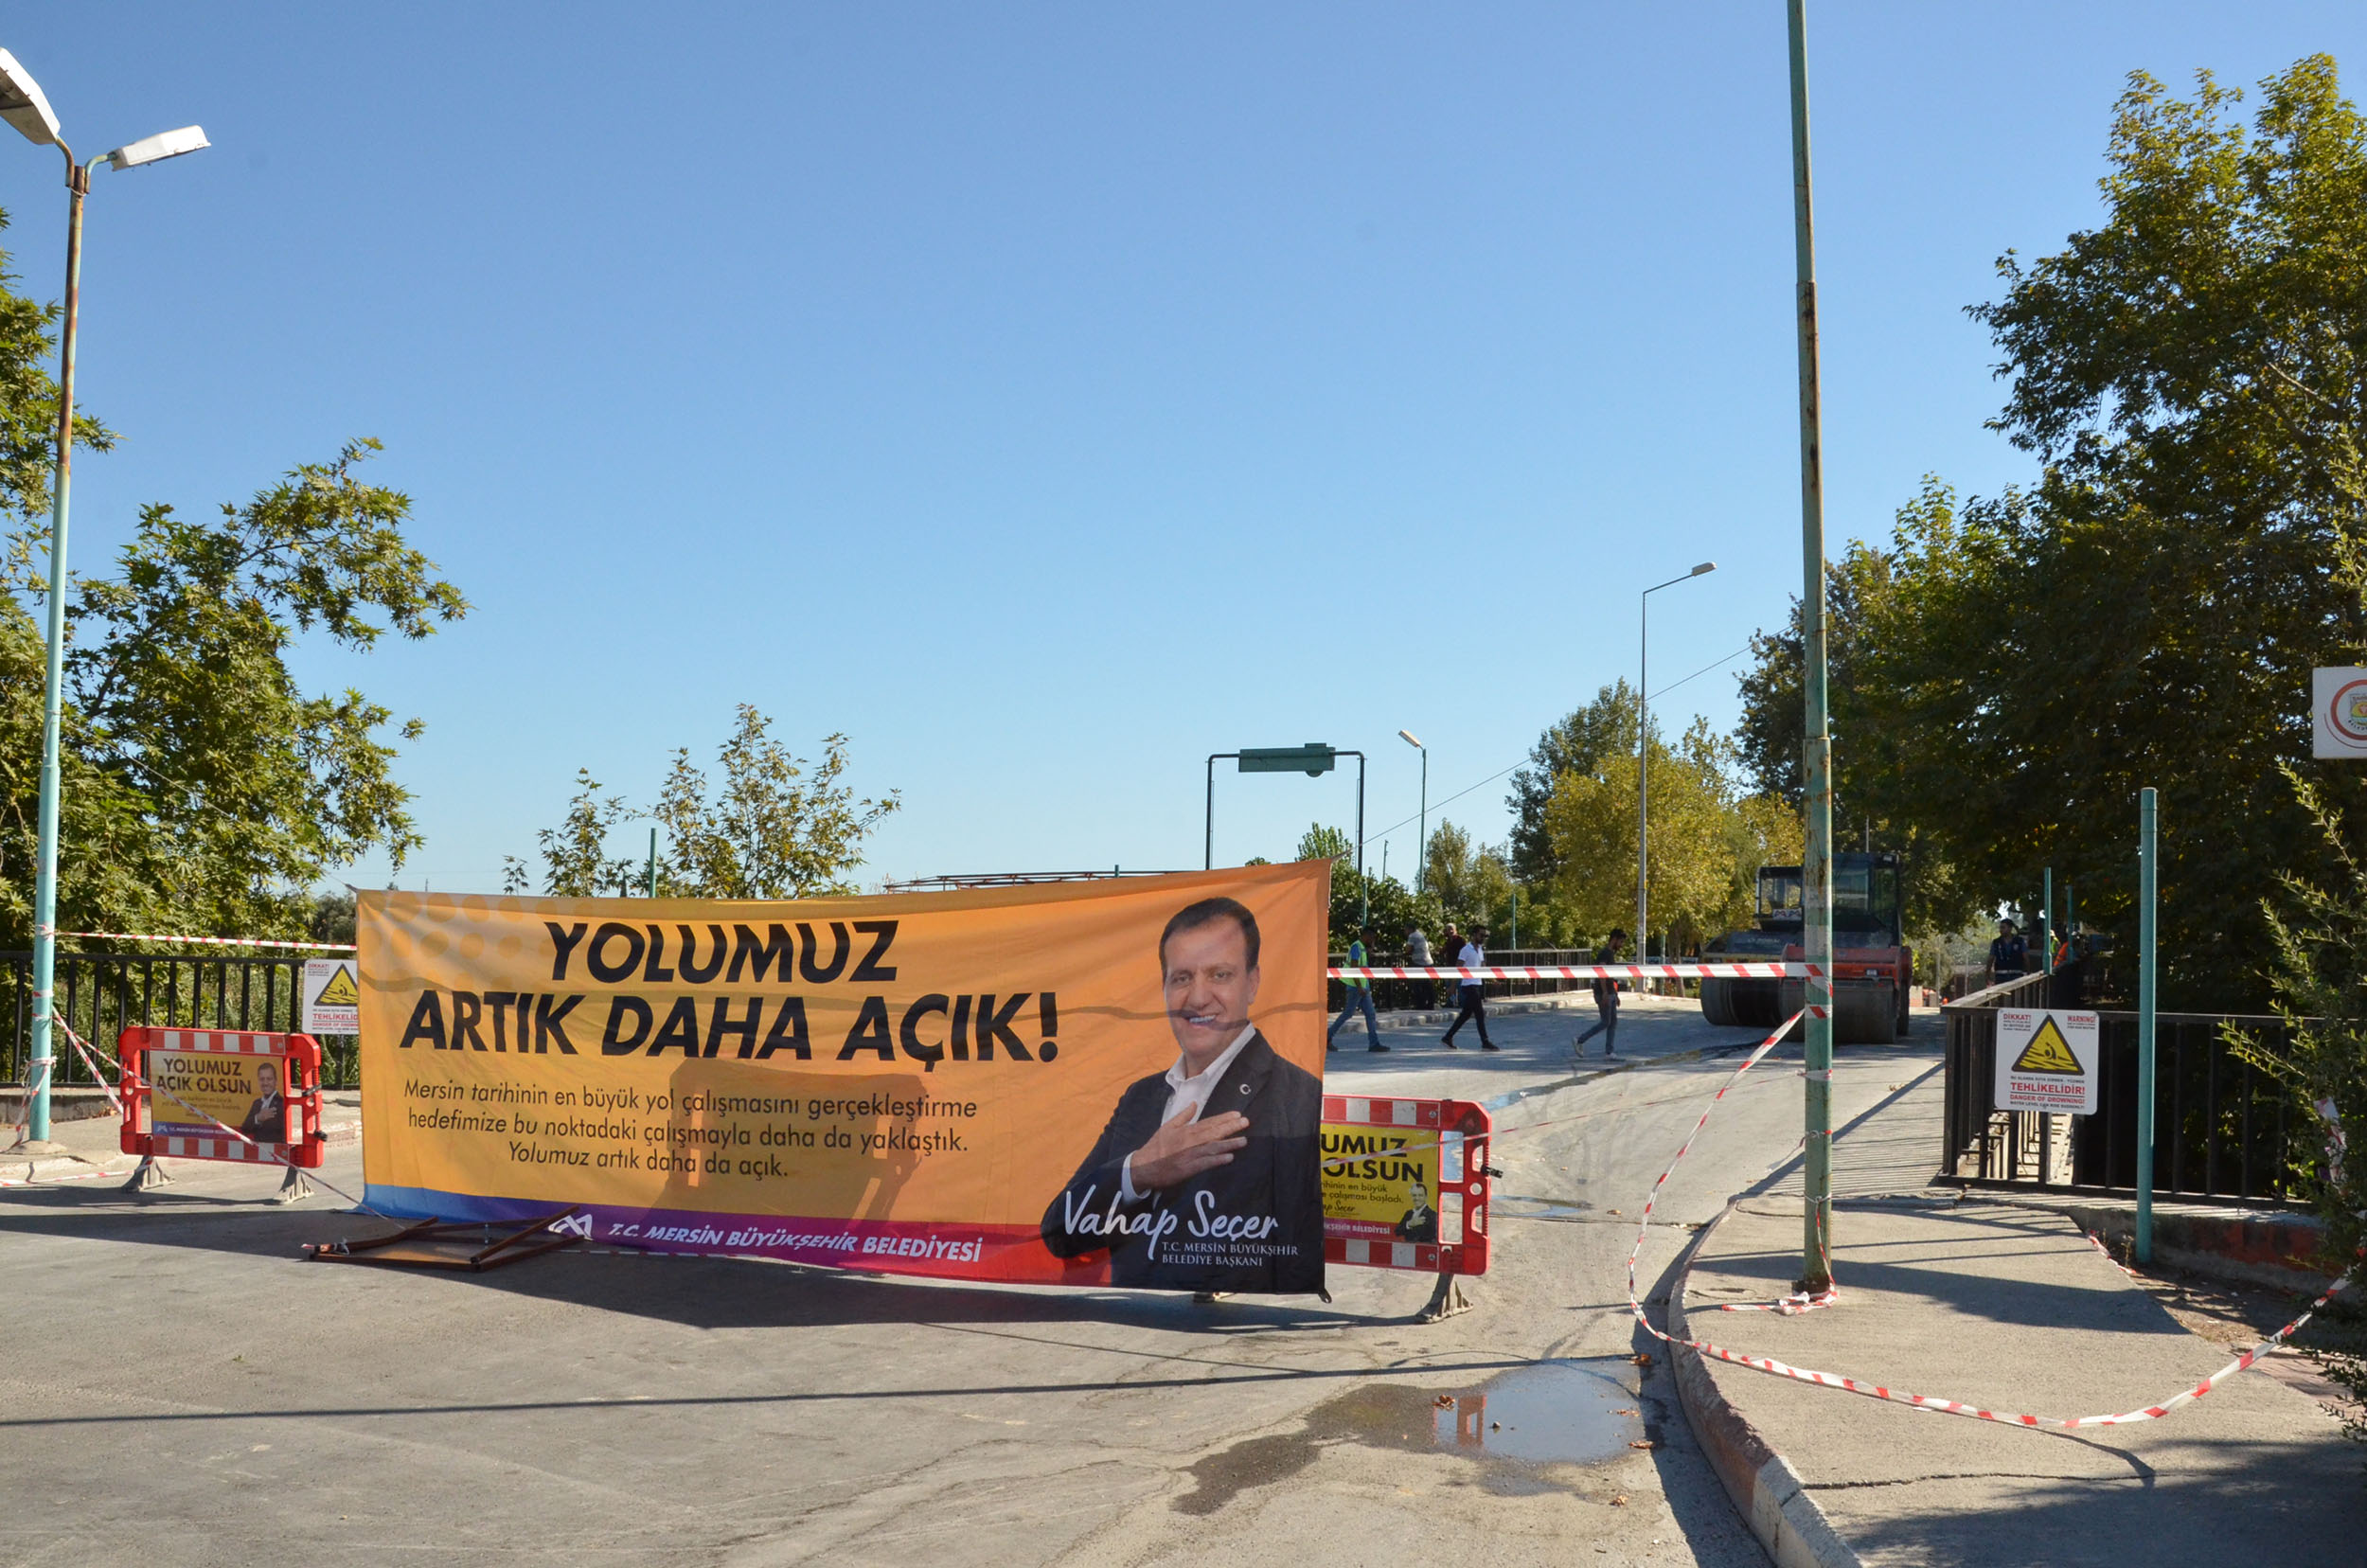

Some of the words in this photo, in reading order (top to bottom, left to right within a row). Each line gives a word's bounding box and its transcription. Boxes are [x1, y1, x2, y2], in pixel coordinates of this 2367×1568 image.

[543, 920, 899, 984] YOLUMUZ
[399, 989, 587, 1056] ARTIK
[601, 995, 811, 1059] DAHA
[836, 991, 1058, 1072] AÇIK!
[163, 1059, 242, 1077] YOLUMUZ
[156, 1076, 193, 1092] AÇIK
[196, 1078, 252, 1095] OLSUN
[404, 1078, 465, 1100] Mersin
[472, 1082, 548, 1106] tarihinin
[555, 1090, 577, 1106] en
[583, 1085, 639, 1113] büyük
[646, 1088, 674, 1112] yol
[682, 1089, 799, 1117] çalışmasını
[808, 1093, 978, 1122] gerçekleştirme
[2010, 1082, 2086, 1096] TEHLİKELİDİR!
[408, 1106, 507, 1132] hedefimize
[513, 1112, 538, 1134] bu
[544, 1115, 636, 1141] noktadaki
[644, 1123, 751, 1149] çalışmayla
[759, 1123, 815, 1148] daha
[824, 1125, 852, 1149] da
[861, 1127, 968, 1156] yaklaştık.
[508, 1140, 590, 1167] Yolumuz
[596, 1147, 639, 1169] artık
[647, 1148, 696, 1173] daha
[704, 1150, 731, 1175] da
[739, 1154, 788, 1181] açık.
[1323, 1156, 1423, 1182] OLSUN
[1361, 1182, 1388, 1193] büyük
[1064, 1184, 1178, 1261] Vahap
[1187, 1189, 1278, 1241] Seçer
[608, 1222, 638, 1238] T.C.
[643, 1223, 724, 1246] MERSİN
[725, 1227, 857, 1253] BÜYÜKŞEHİR
[862, 1234, 983, 1262] BELEDİYESİ
[1162, 1241, 1182, 1252] T.C.
[1184, 1240, 1227, 1254] MERSİN
[1230, 1242, 1300, 1256] BÜYÜKŞEHİR
[1162, 1253, 1213, 1265] BELEDİYE
[1215, 1256, 1264, 1268] BAŞKANI
